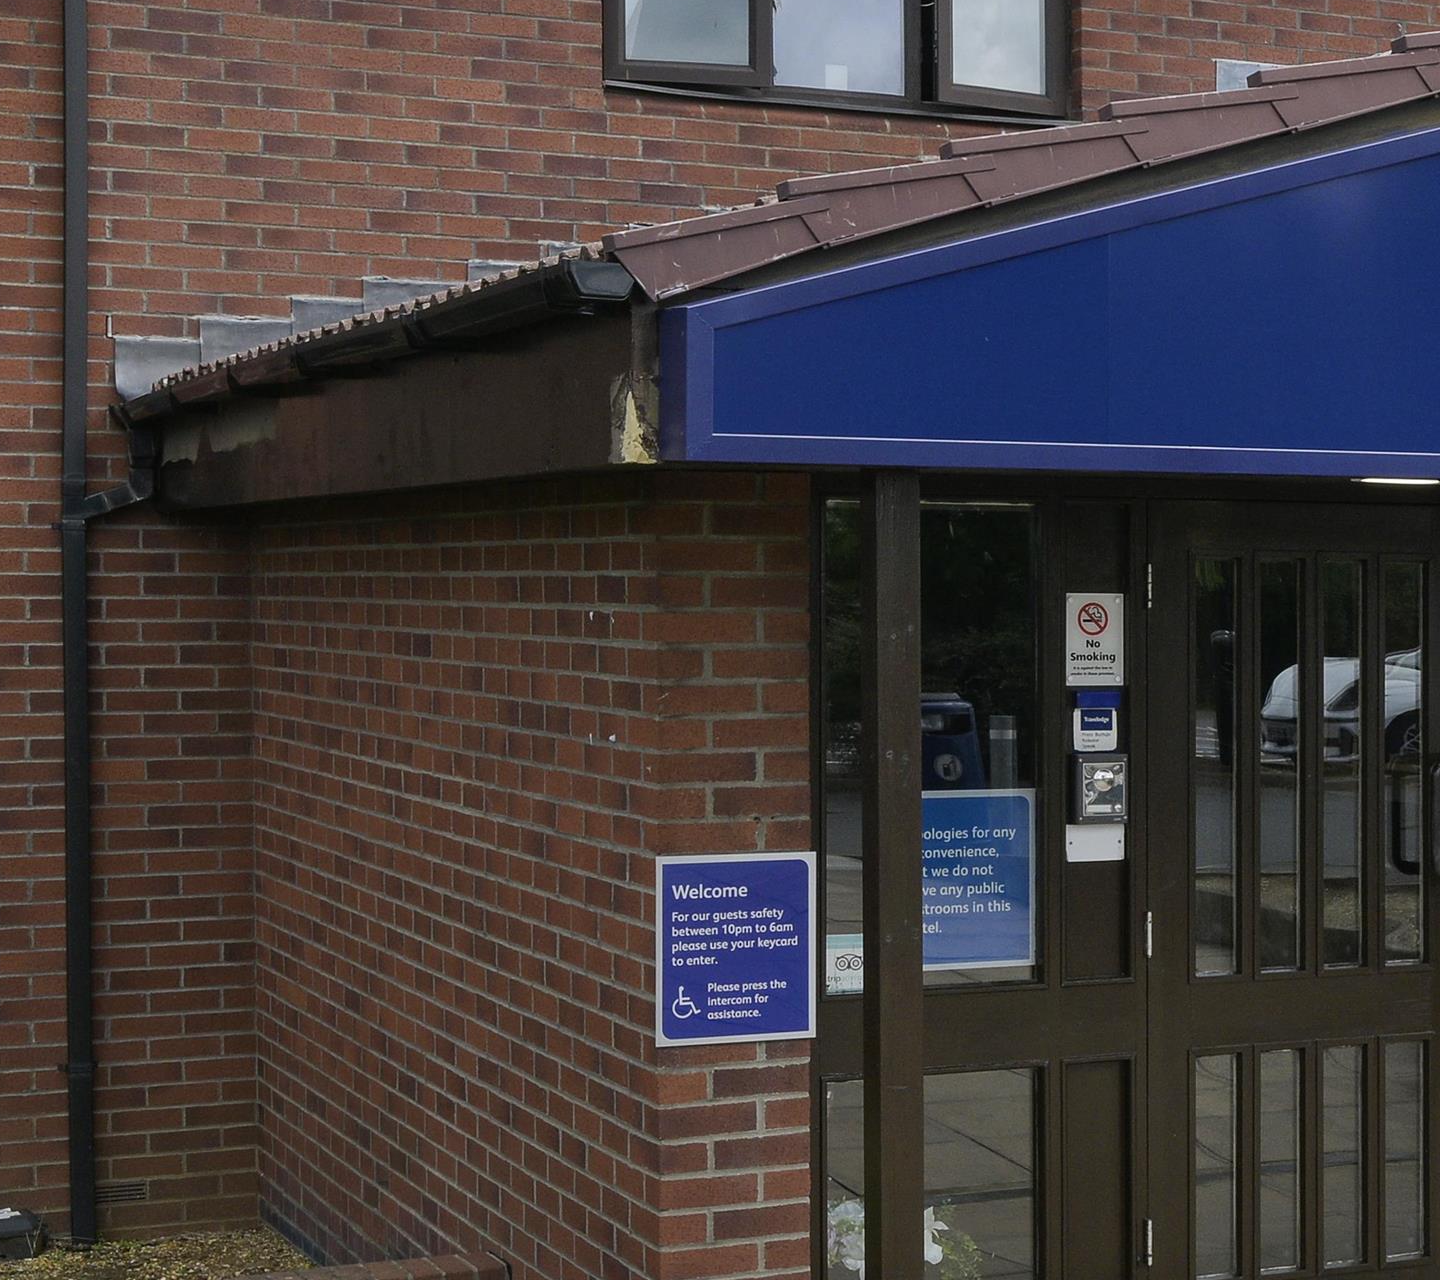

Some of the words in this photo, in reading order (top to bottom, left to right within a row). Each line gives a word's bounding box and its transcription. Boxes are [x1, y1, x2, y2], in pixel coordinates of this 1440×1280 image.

[1085, 639, 1101, 649] No
[1070, 652, 1116, 664] Smoking
[972, 825, 990, 839] for
[993, 826, 1016, 841] any
[931, 867, 949, 877] we
[952, 864, 968, 876] do
[972, 864, 993, 876] not
[671, 883, 748, 900] Welcome
[940, 885, 964, 898] any
[967, 882, 1005, 898] public
[972, 901, 984, 913] in
[987, 899, 1011, 913] this
[672, 911, 689, 923] For
[691, 912, 711, 921] our
[712, 909, 748, 923] guests
[750, 907, 784, 921] safety
[671, 926, 719, 937] between
[722, 923, 753, 937] 10pm
[755, 924, 767, 933] to
[769, 922, 794, 933] 6am
[671, 941, 707, 954] please
[709, 941, 728, 950] use
[730, 939, 755, 951] your
[757, 935, 799, 950] keycard
[671, 956, 684, 967] to
[686, 955, 719, 966] enter.
[707, 982, 740, 993] Please
[742, 981, 768, 993] press
[769, 979, 787, 989] the
[707, 996, 752, 1006] intercom
[754, 993, 769, 1003] for
[707, 1009, 762, 1020] assistance.
